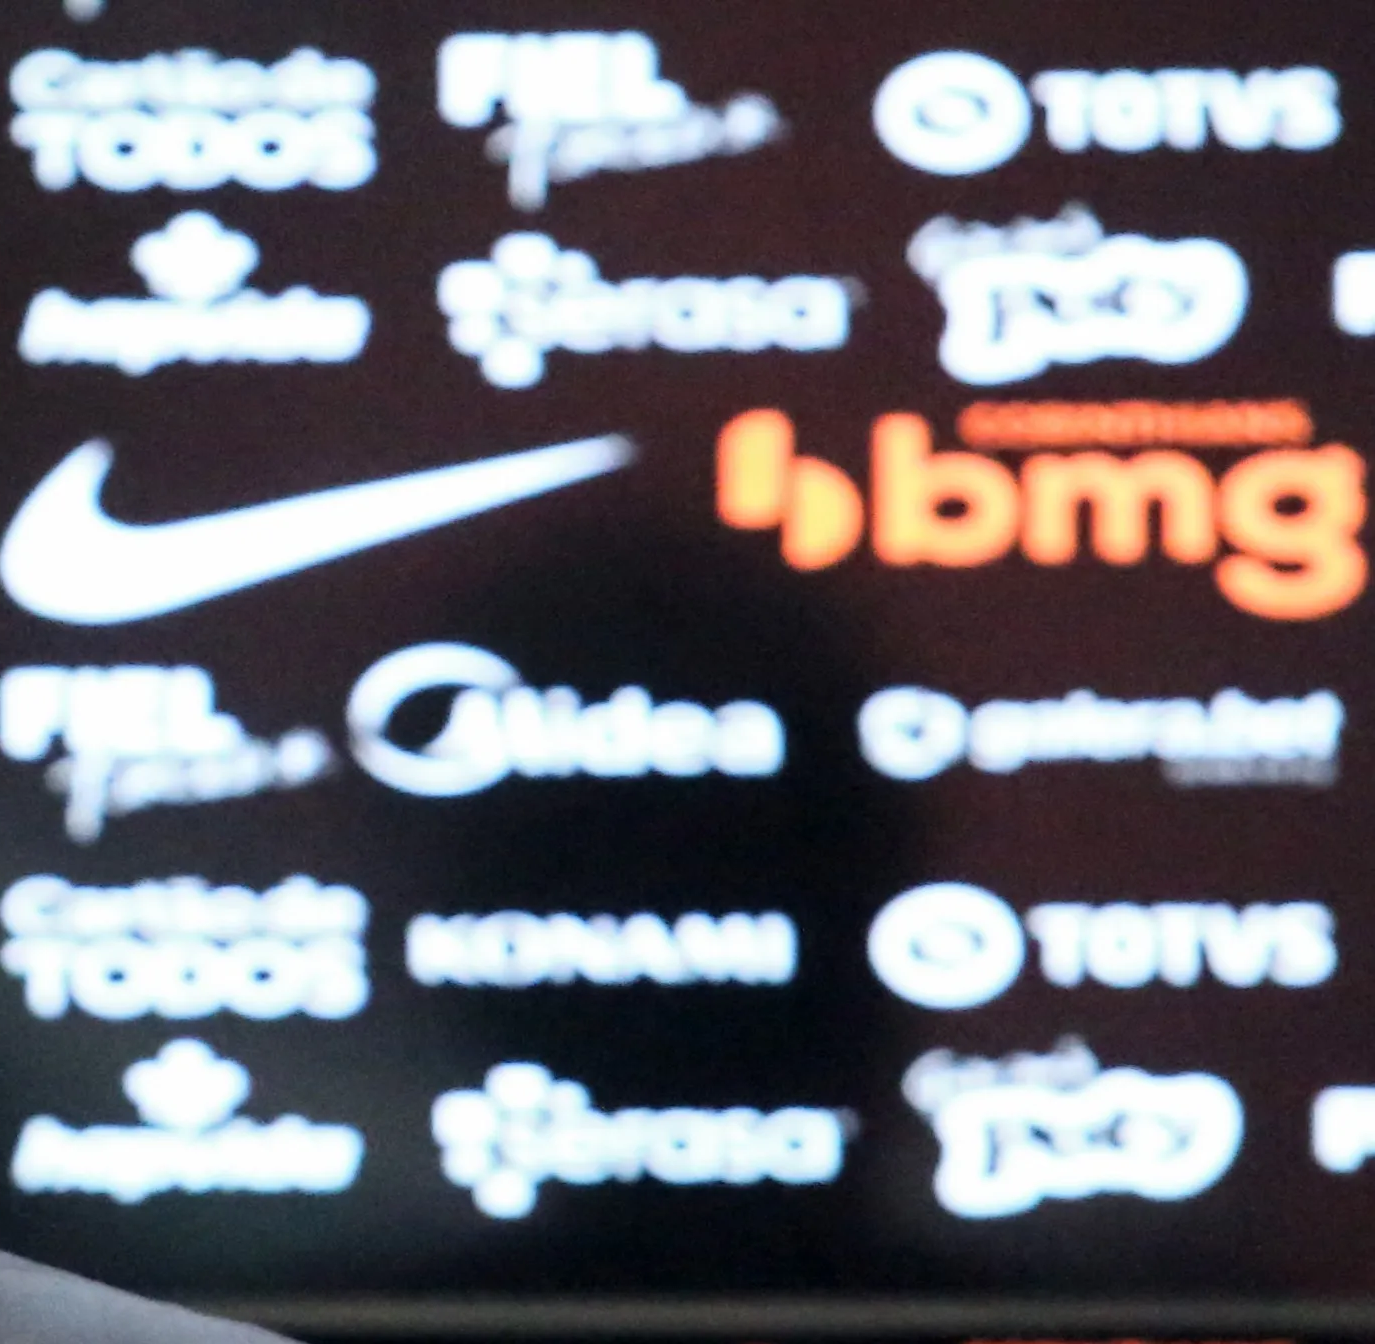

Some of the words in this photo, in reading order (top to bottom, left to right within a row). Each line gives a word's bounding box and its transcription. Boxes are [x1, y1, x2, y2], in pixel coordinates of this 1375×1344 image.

[1029, 66, 1342, 153] TOTVS
[867, 405, 1369, 621] bmg
[434, 687, 785, 777] Midea
[405, 910, 798, 987] KONAMI
[1026, 901, 1338, 988] TOTVS
